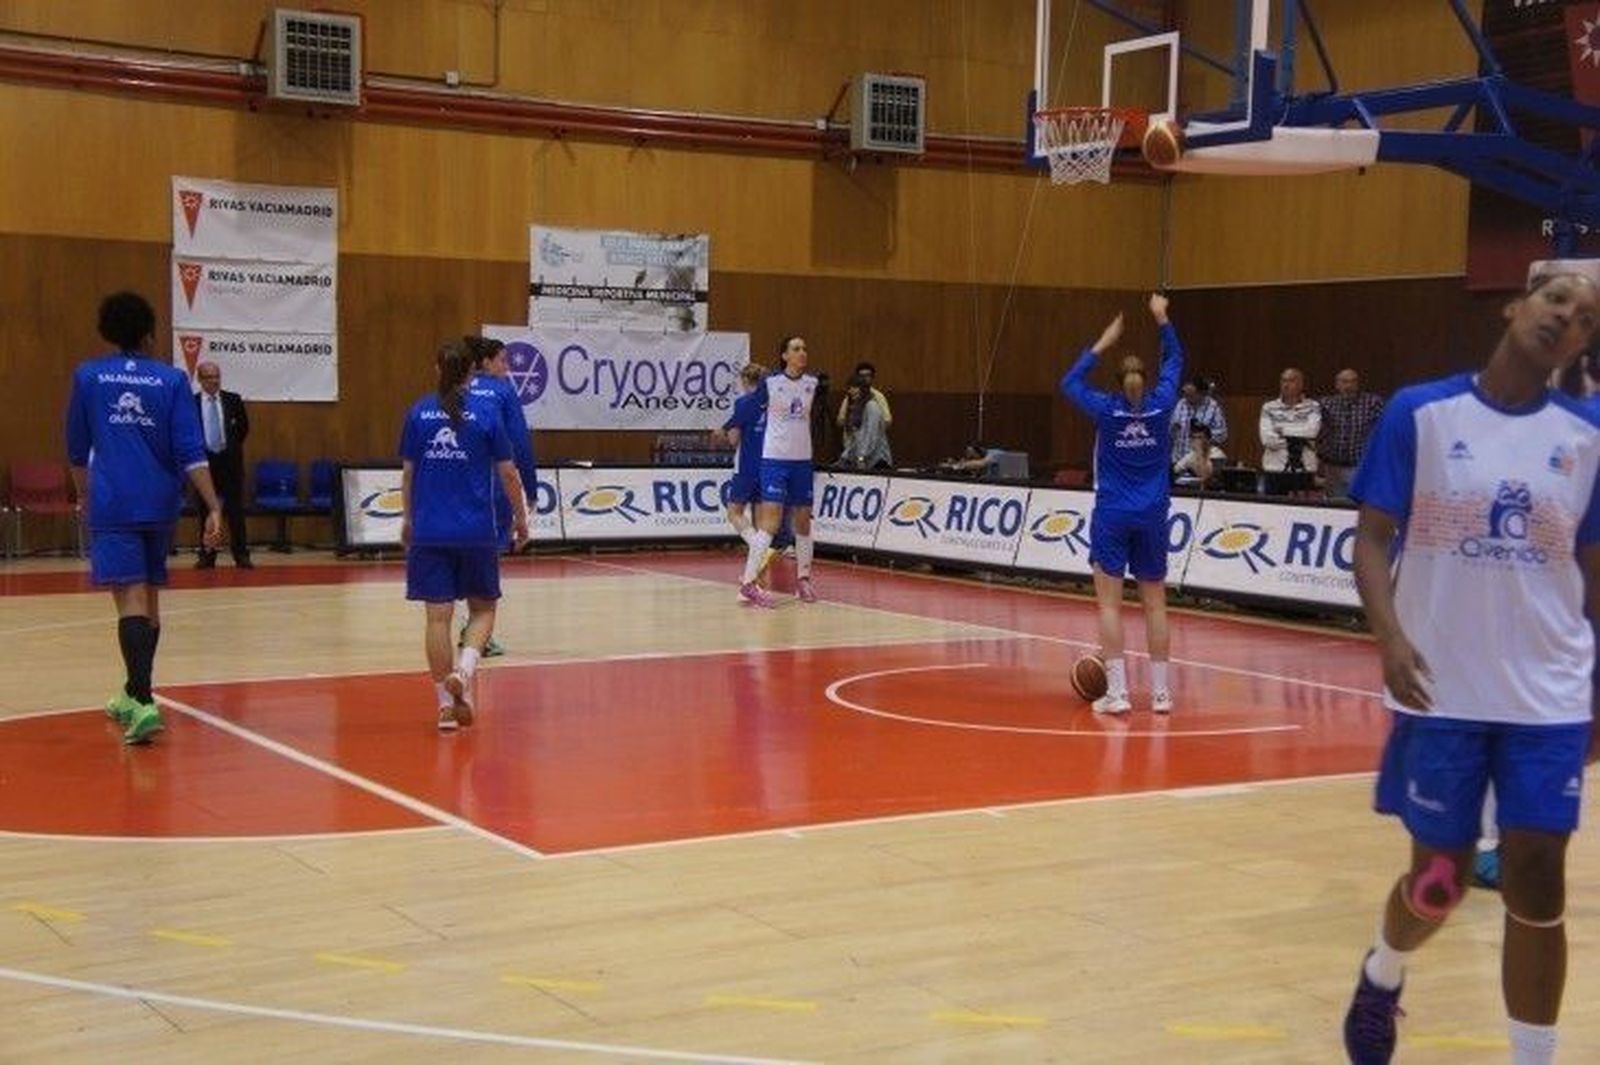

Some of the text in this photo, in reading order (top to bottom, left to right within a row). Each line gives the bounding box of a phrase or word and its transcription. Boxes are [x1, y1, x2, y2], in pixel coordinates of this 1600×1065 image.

[209, 199, 334, 218] RIVAS VACIAMADRID
[208, 271, 332, 288] RIVAS VACIAMADRID
[209, 342, 332, 356] RIVAS VACIAMADRID
[557, 344, 732, 409] Cryovac
[621, 392, 730, 411] Anevac
[653, 480, 733, 514] RIC
[819, 484, 883, 522] RICO
[945, 494, 1023, 537] RICO
